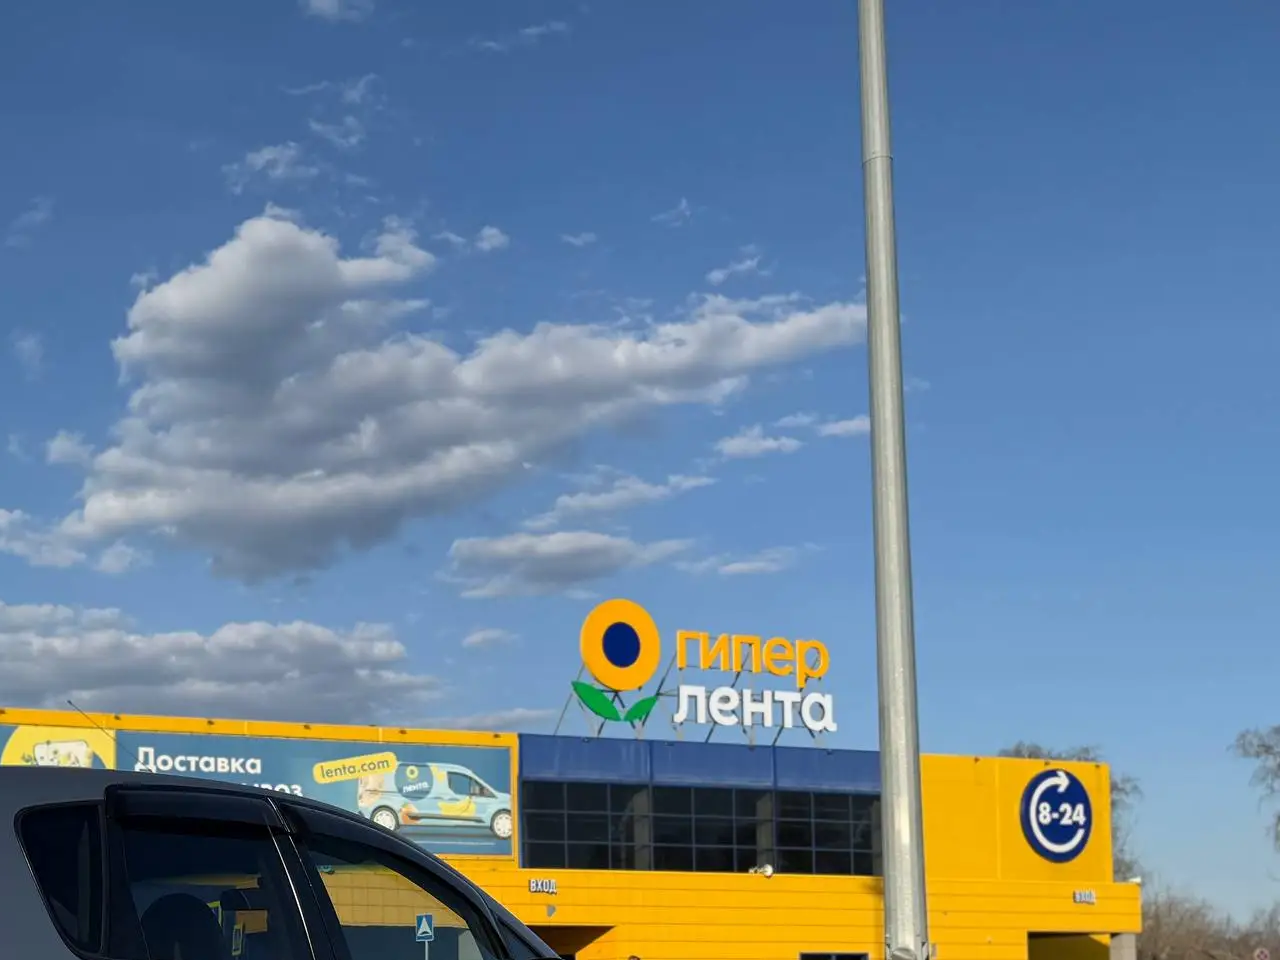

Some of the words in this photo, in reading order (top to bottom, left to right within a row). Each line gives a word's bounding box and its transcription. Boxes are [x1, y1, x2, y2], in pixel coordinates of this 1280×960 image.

[676, 629, 829, 689] гипер
[673, 685, 837, 732] лента
[134, 746, 262, 774] Доставка
[320, 757, 390, 779] lenta.com
[1037, 801, 1087, 826] 8-24
[529, 878, 557, 894] ВХОД
